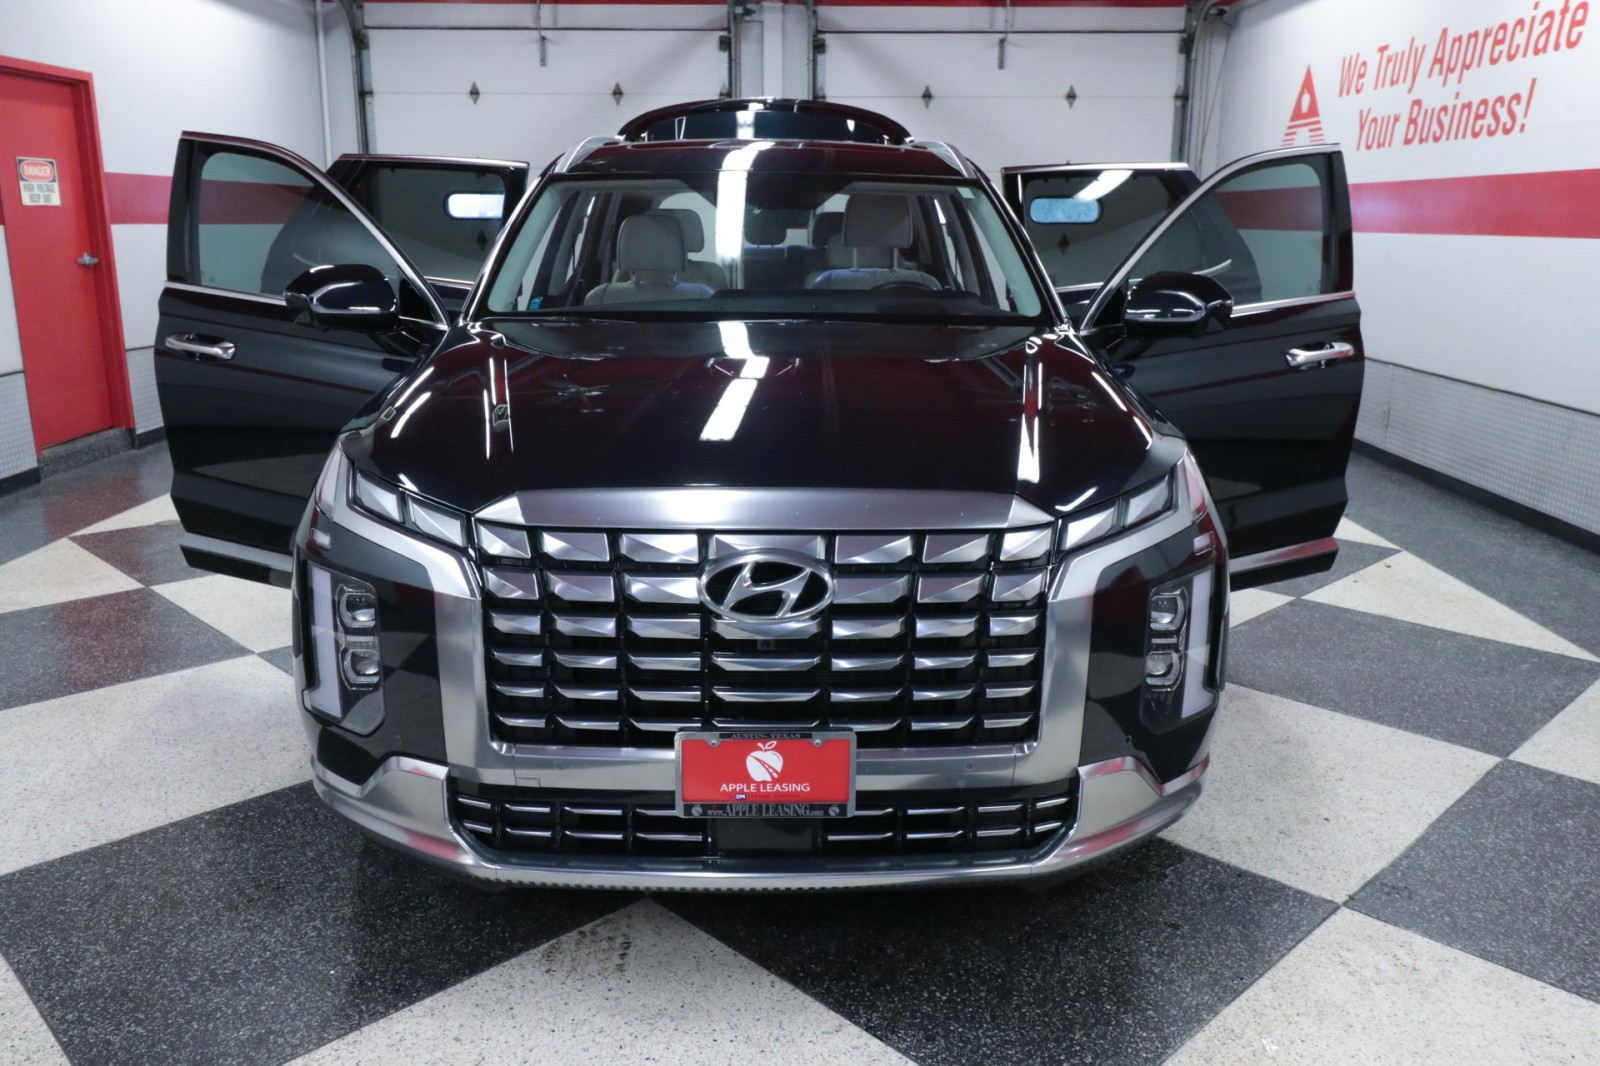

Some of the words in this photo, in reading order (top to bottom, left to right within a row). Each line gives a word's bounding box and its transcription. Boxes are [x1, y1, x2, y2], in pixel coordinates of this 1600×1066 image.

[1338, 53, 1368, 98] We
[1373, 36, 1427, 95] Truly
[1427, 0, 1590, 87] Appreciate
[1355, 107, 1401, 152] Your
[1403, 77, 1538, 146] Business!
[23, 164, 50, 176] DANGER
[23, 184, 34, 192] HIGH
[36, 184, 56, 193] VOLTAGE
[30, 193, 41, 203] KEEP
[43, 194, 52, 204] OUT
[770, 732, 801, 740] TEXAS
[720, 783, 757, 792] APPLE
[760, 783, 811, 792] LEASING
